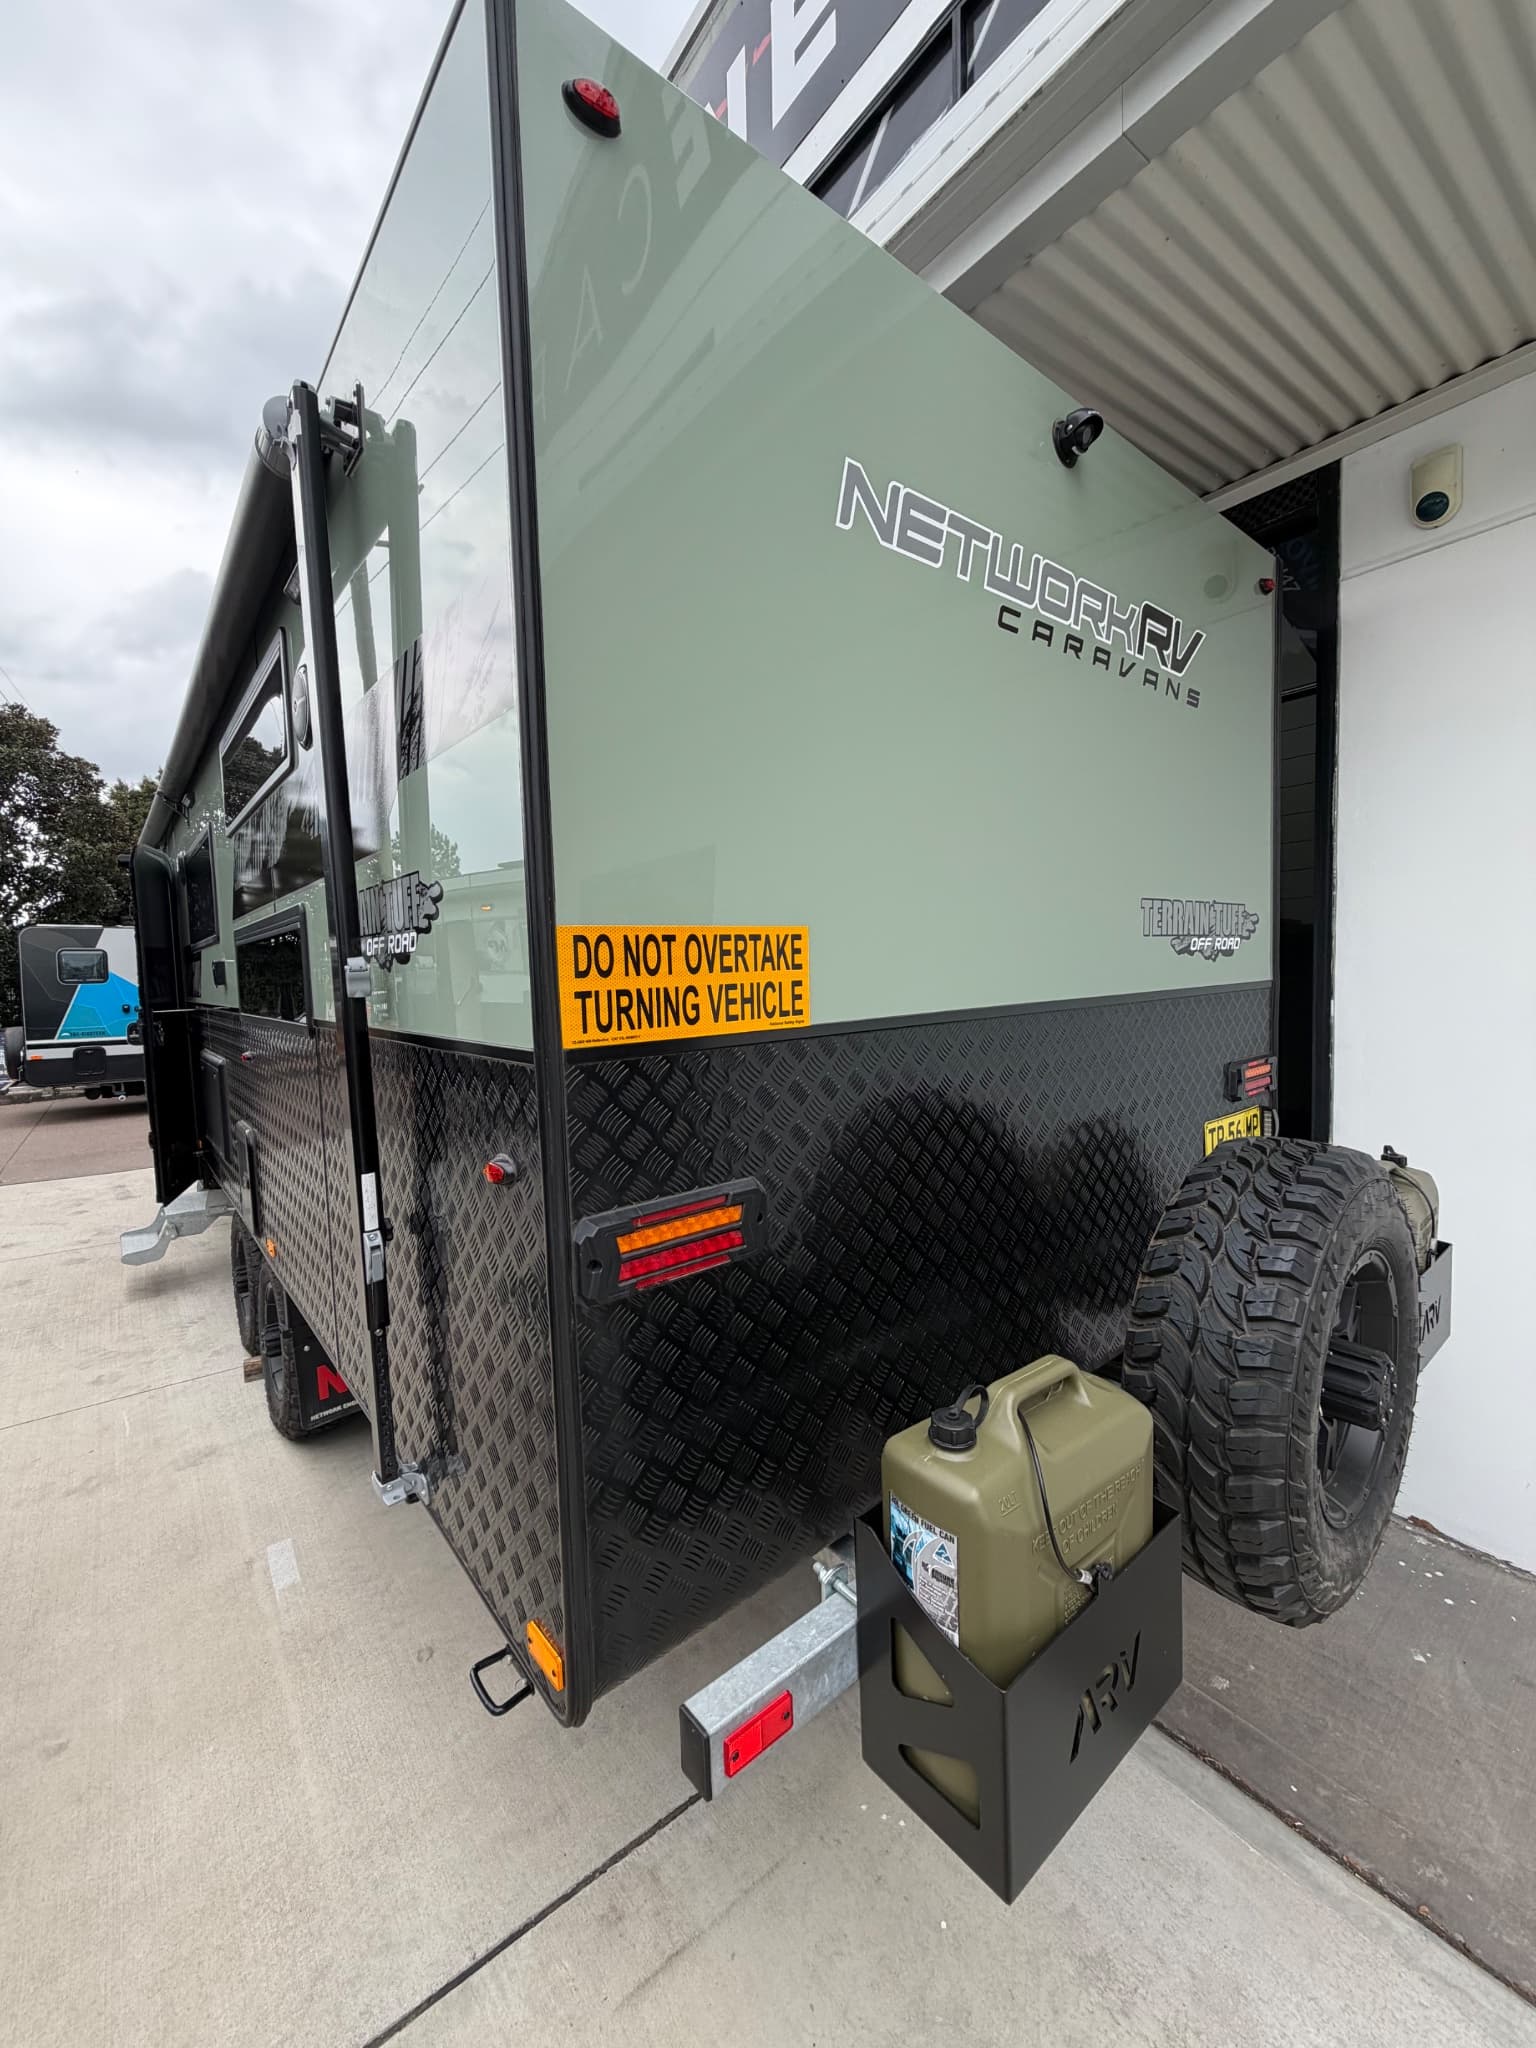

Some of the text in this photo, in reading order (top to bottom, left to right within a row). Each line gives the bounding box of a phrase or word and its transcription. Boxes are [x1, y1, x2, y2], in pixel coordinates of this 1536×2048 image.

[997, 605, 1200, 708] CARAVANS
[1140, 897, 1210, 937] TERRAIN
[366, 931, 417, 956] OFF ROAD
[573, 933, 803, 979] DO NOT OVERTAKE
[1190, 937, 1241, 951] OFF ROAD
[574, 980, 803, 1034] TURNING VEHICLE
[1059, 1509, 1080, 1535] OUT
[1079, 1497, 1093, 1519] OF
[1093, 1483, 1115, 1506] THE
[1114, 1458, 1145, 1492] REACH
[920, 1519, 938, 1537] FUEL
[939, 1530, 955, 1545] CAN
[1062, 1502, 1118, 1555] OF CHILDREN
